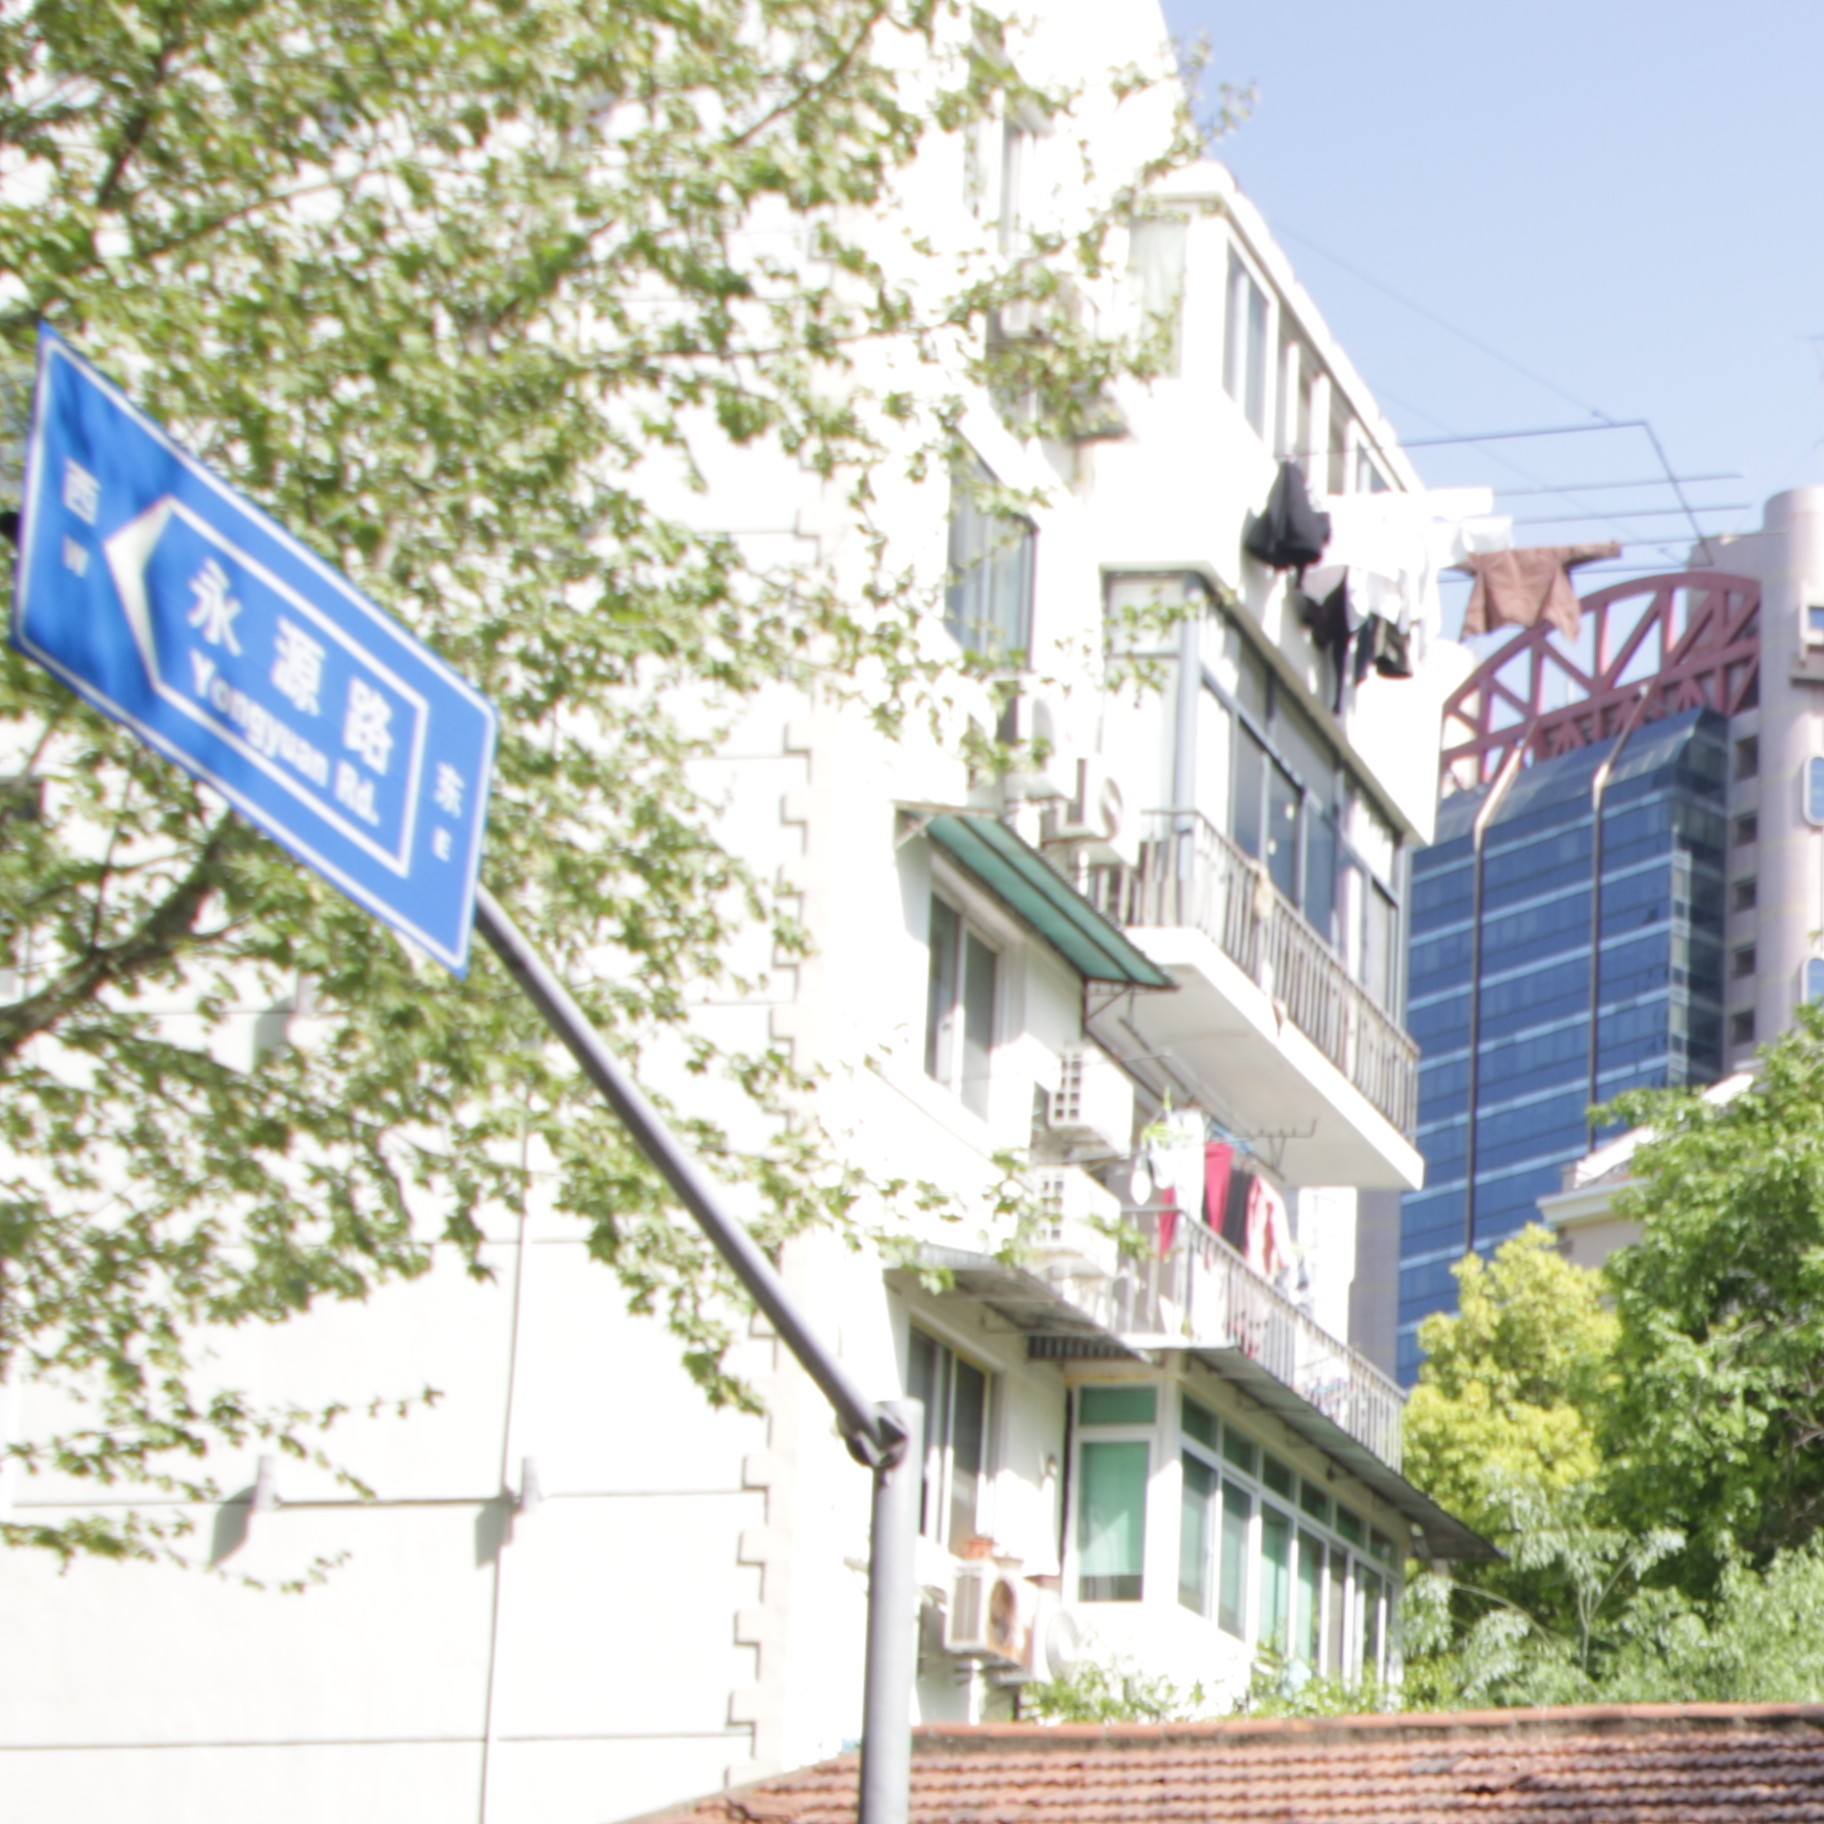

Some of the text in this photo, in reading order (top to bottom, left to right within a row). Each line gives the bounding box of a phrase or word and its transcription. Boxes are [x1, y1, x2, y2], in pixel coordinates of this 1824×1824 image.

[64, 456, 101, 527] 西
[187, 556, 393, 776] 永源路
[190, 648, 329, 788] Yongyuan
[434, 762, 465, 819] 东
